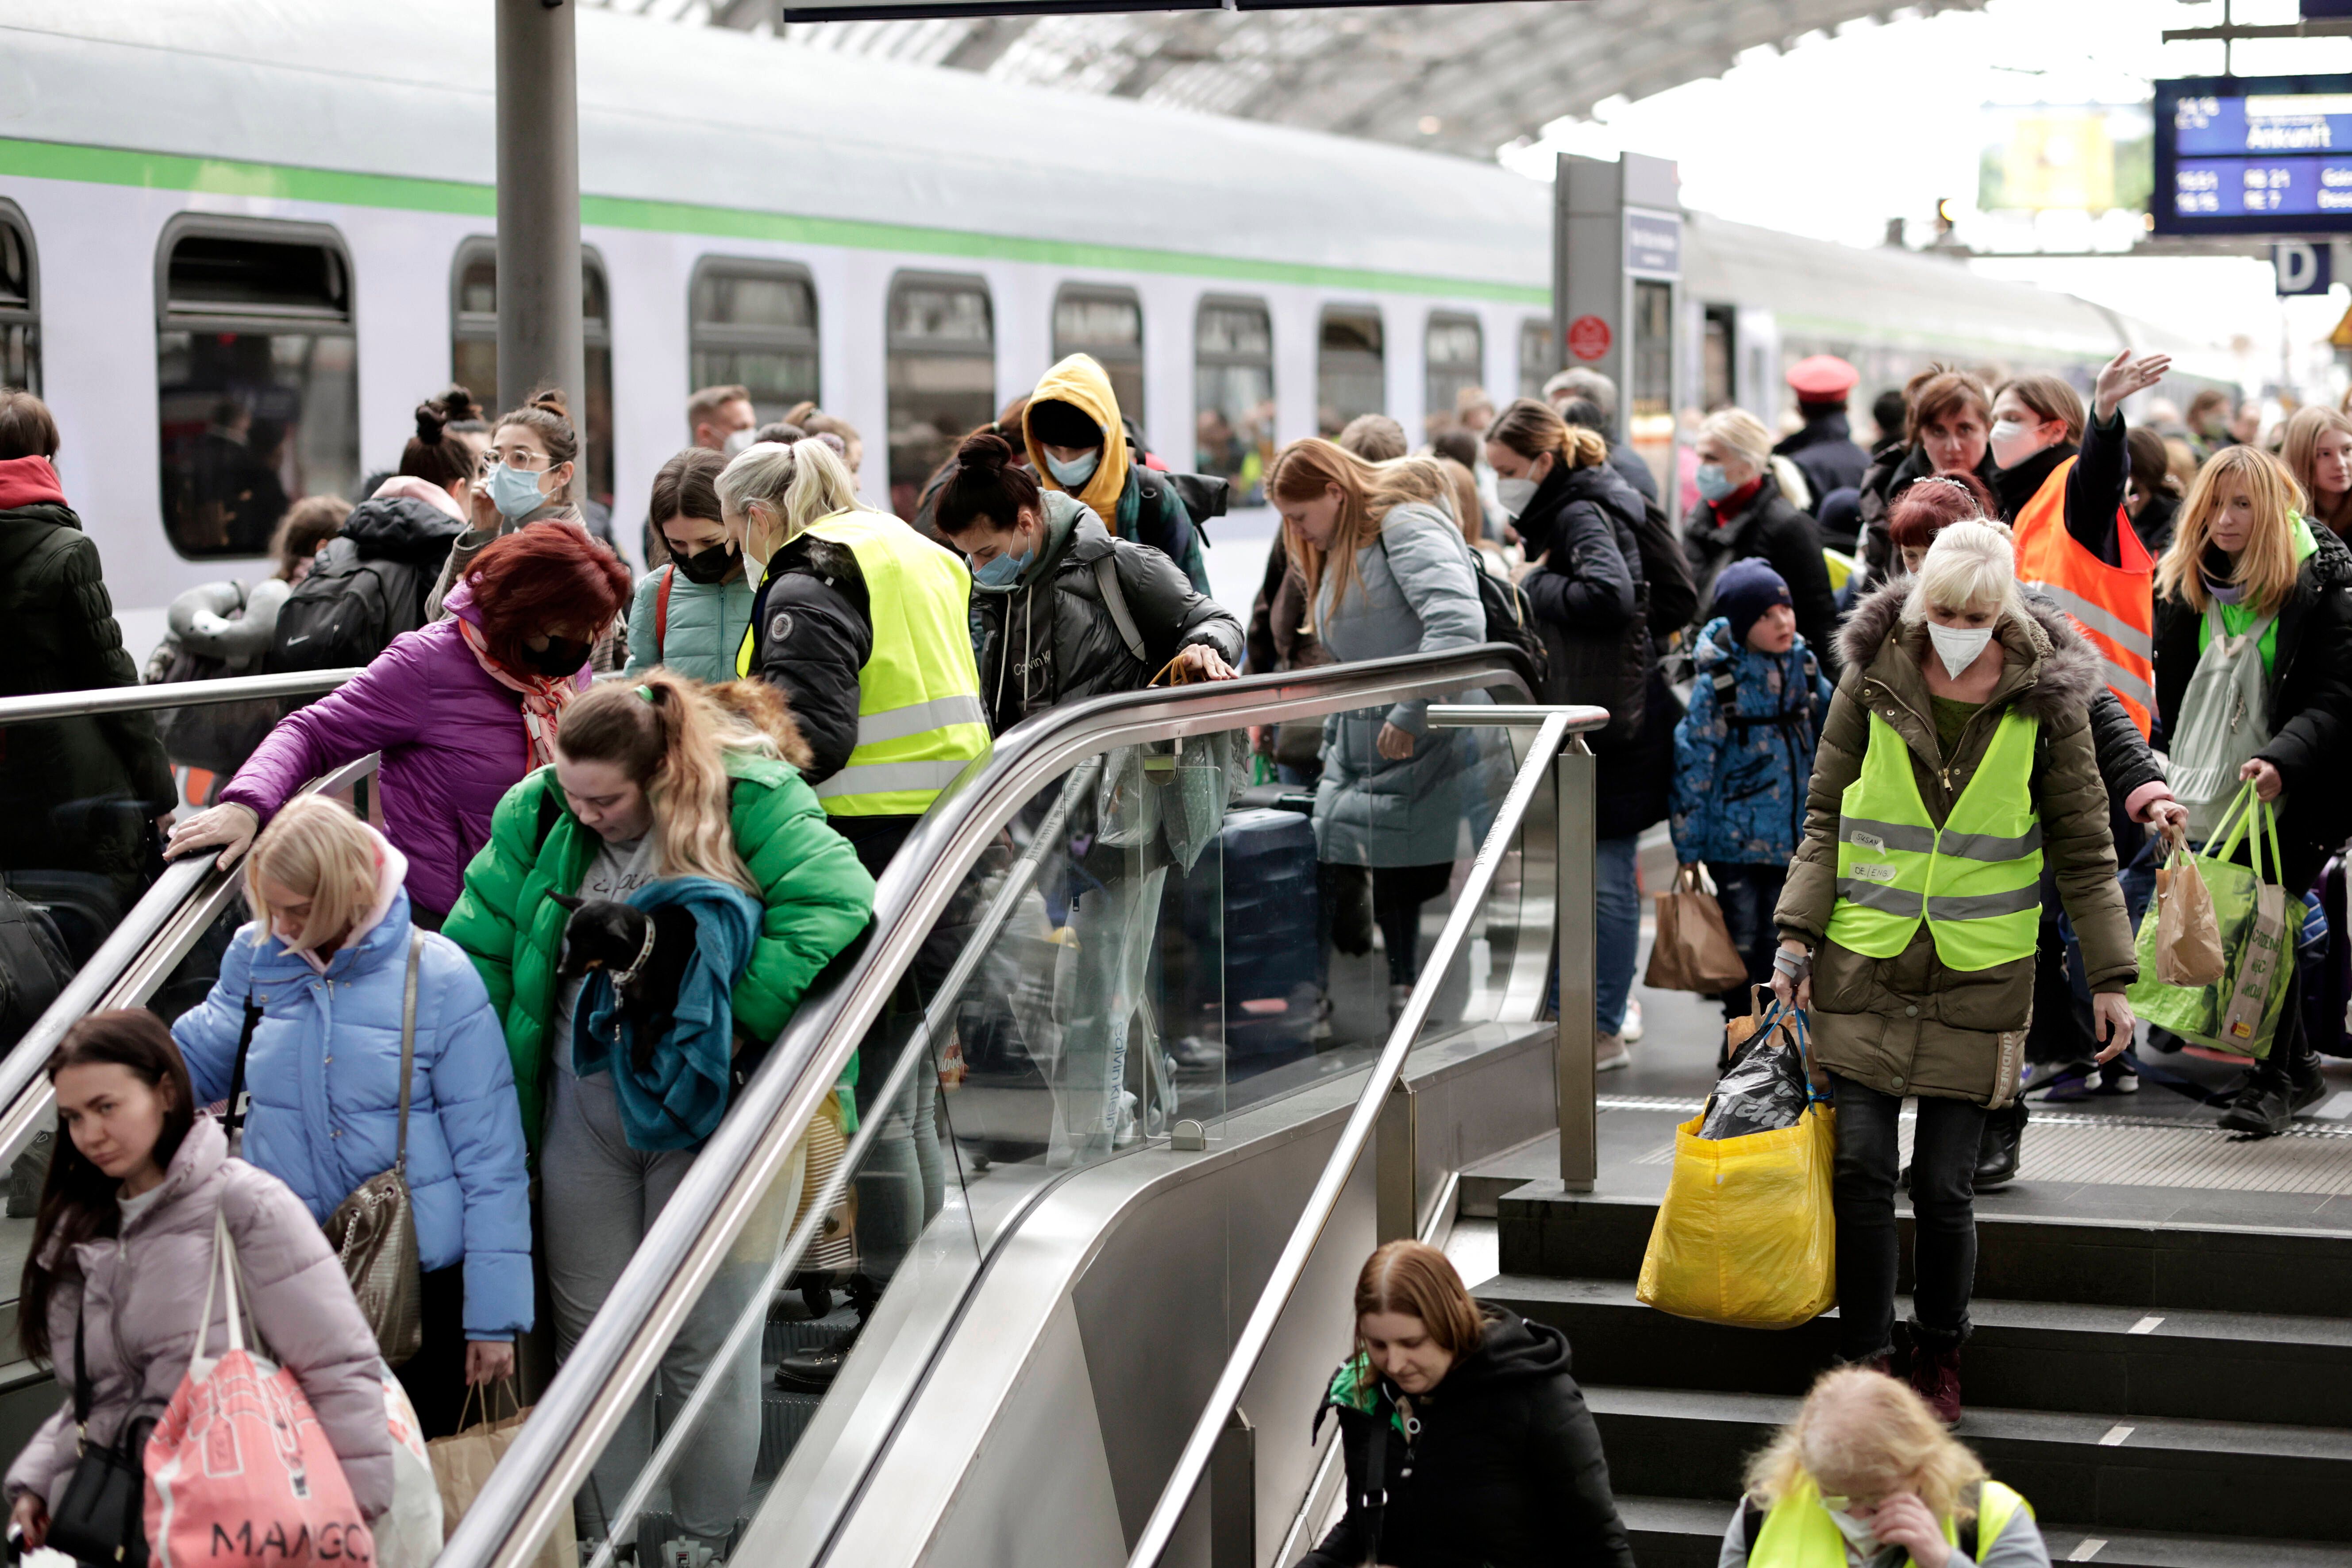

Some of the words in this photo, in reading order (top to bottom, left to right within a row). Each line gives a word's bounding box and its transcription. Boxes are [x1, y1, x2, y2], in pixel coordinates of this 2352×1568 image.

[2245, 123, 2333, 150] Ankunft
[2278, 240, 2318, 292] D
[1013, 657, 1043, 676] Cavin
[1856, 833, 1879, 846] SUSAN
[1995, 1032, 2013, 1103] KINDNESS
